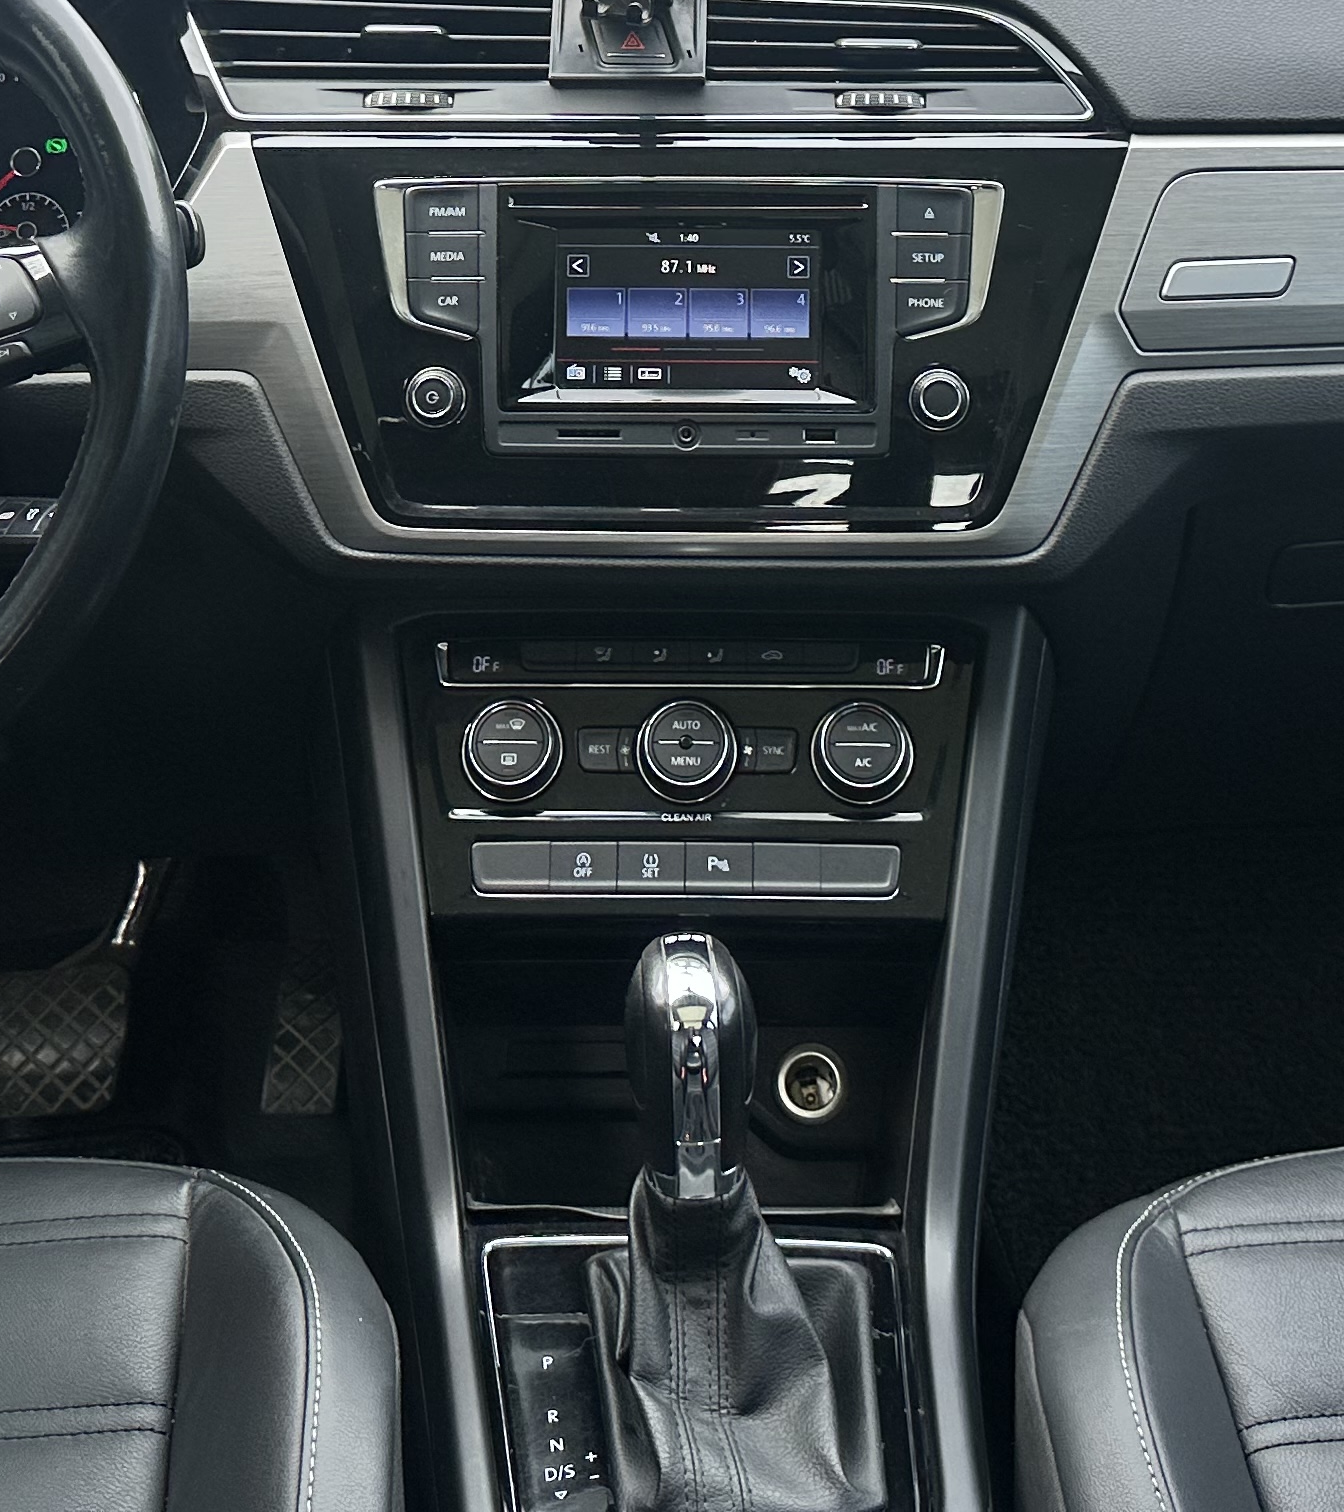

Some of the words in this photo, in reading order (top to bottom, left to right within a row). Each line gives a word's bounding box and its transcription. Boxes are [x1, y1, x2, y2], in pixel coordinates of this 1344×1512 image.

[679, 233, 699, 243] 1:40
[429, 250, 465, 262] MEDIA
[911, 251, 945, 264] SETUP
[660, 259, 693, 275] 87.1
[437, 295, 459, 307] CAR
[616, 292, 623, 305] 1
[674, 292, 683, 306] 2
[736, 292, 745, 306] 3
[796, 293, 806, 306] 4
[907, 296, 945, 309] PHONE
[672, 719, 701, 730] AUTO
[588, 744, 611, 754] REST
[762, 745, 785, 756] SYNC
[670, 755, 701, 767] MENU
[854, 757, 872, 768] A/C
[661, 813, 693, 823] CLEAN
[694, 813, 712, 823] AIR
[573, 867, 593, 878] OFF
[641, 867, 660, 878] SET
[542, 1355, 554, 1370] P
[547, 1409, 559, 1424] R
[549, 1438, 565, 1452] N
[544, 1464, 576, 1483] D/S
